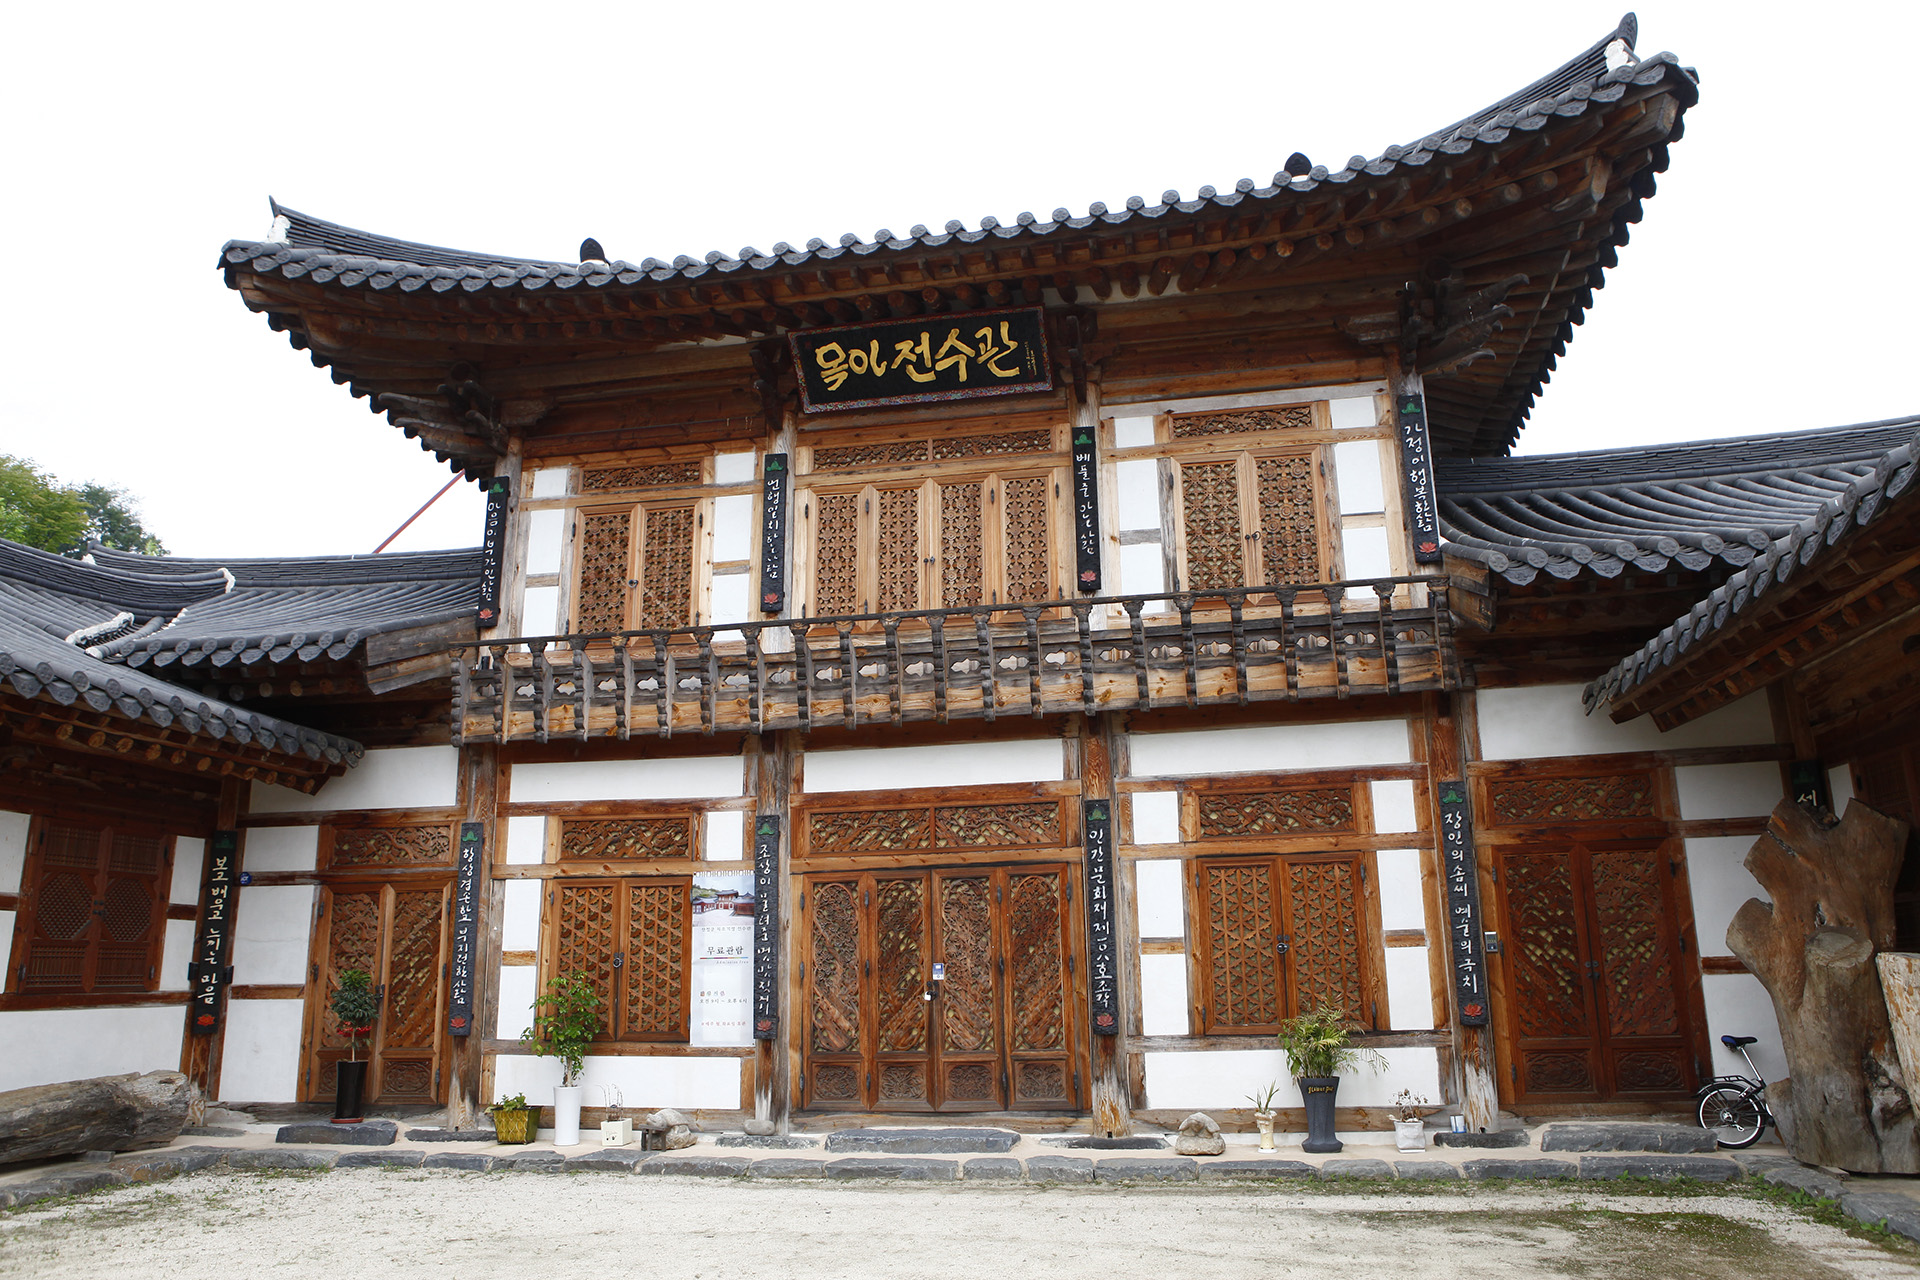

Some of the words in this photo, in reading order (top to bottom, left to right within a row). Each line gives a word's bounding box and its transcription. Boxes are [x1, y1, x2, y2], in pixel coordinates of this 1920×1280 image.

[1404, 423, 1424, 465] 가정이
[1409, 468, 1430, 513] 행복한
[1444, 810, 1464, 862] 장인의
[212, 856, 229, 882] 보고
[461, 847, 475, 877] 항상
[757, 844, 772, 885] 조상이
[1449, 864, 1468, 897] 솜씨
[207, 885, 228, 921] 배우고
[457, 878, 472, 923] 겸손하고
[204, 927, 221, 965] 느끼는
[1455, 903, 1472, 955] 예술의
[455, 927, 468, 978] 부지런한
[707, 945, 744, 956] 무료관람
[197, 972, 219, 1005] 마음
[1458, 957, 1477, 994] 극치
